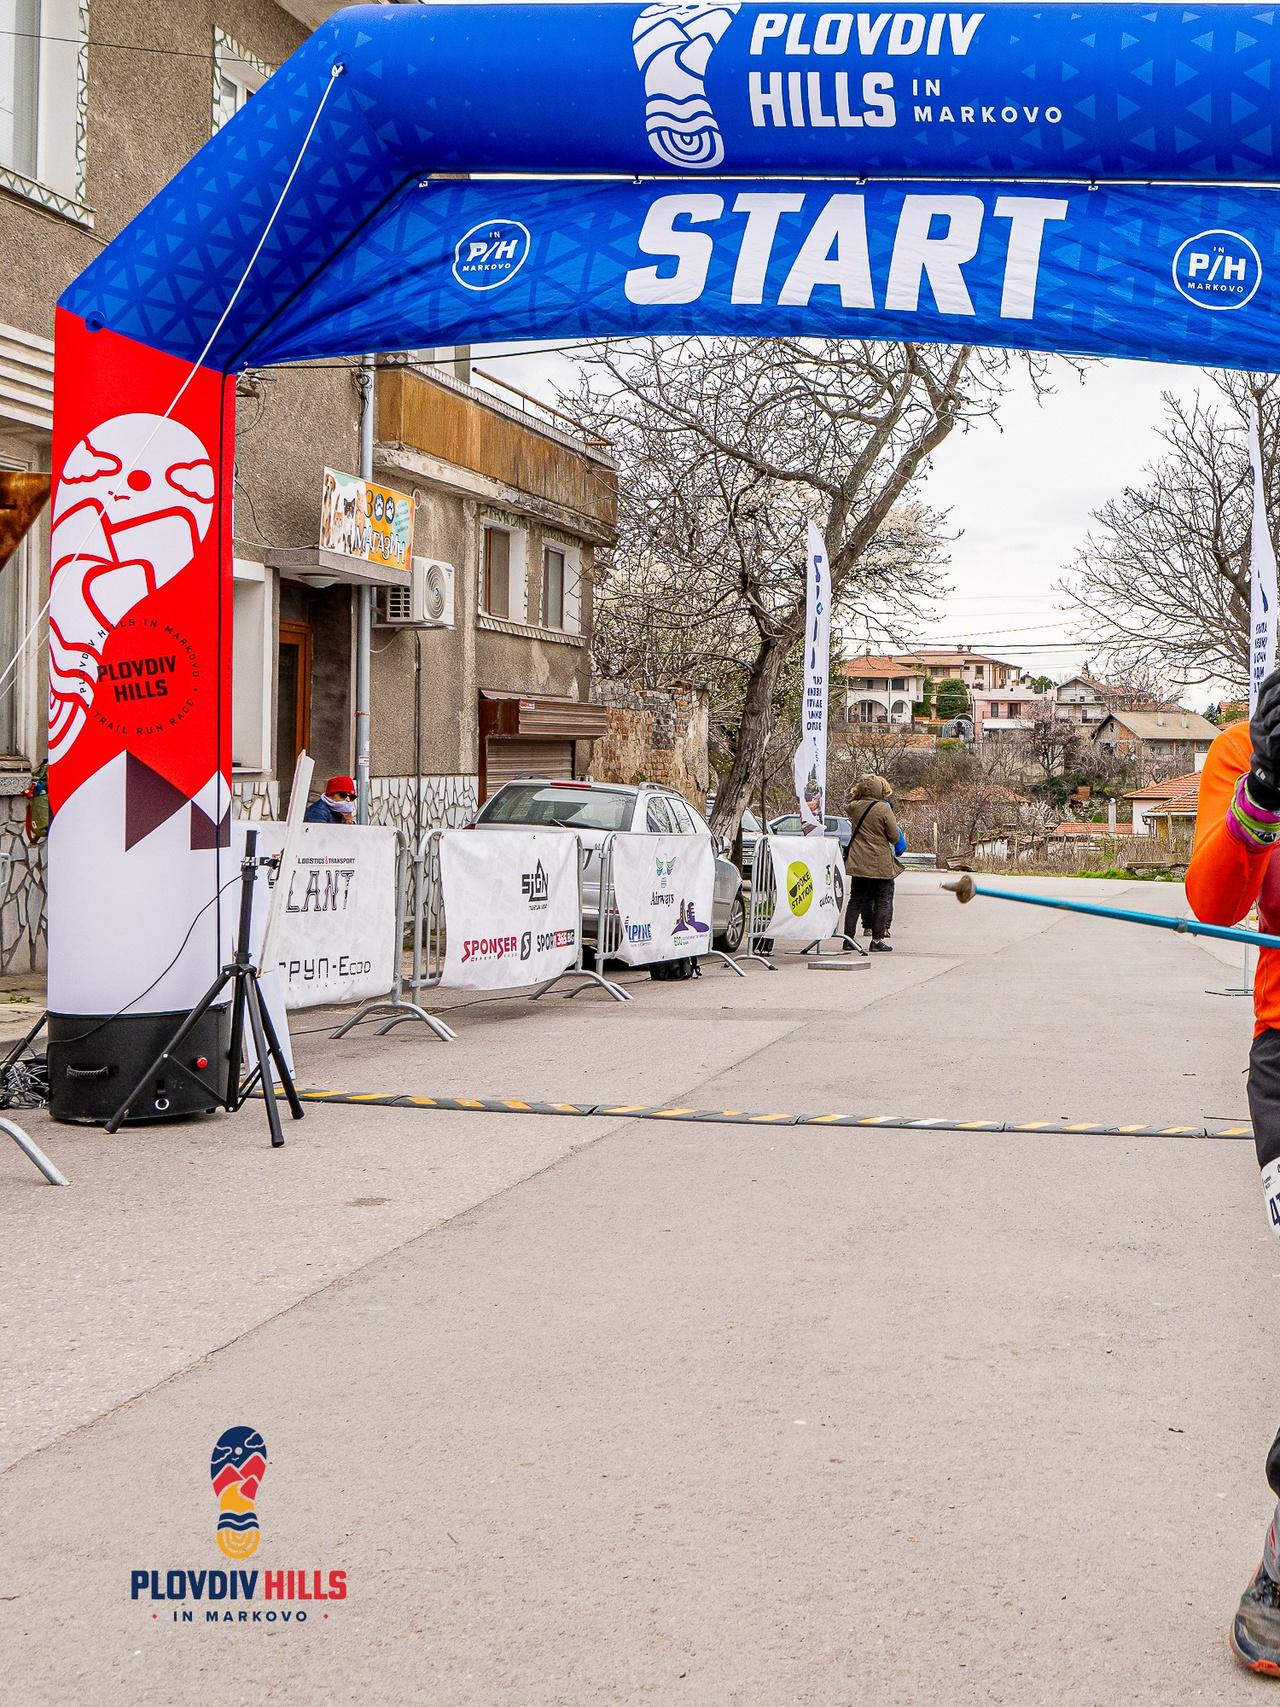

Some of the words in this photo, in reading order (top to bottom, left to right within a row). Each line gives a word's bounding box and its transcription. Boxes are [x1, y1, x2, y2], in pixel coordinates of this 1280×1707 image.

[749, 12, 986, 56] PLOVDIV
[748, 71, 897, 128] HILLS
[912, 79, 941, 97] IN
[914, 106, 1063, 124] MARKOVO
[489, 231, 501, 239] IN
[466, 239, 519, 263] P/H
[624, 192, 1070, 320] START
[1213, 246, 1225, 254] IN
[462, 262, 512, 272] MARKOVO
[1188, 252, 1247, 282] P/H
[1187, 282, 1244, 294] MARKOVO
[354, 525, 406, 565] МАГАЗИН
[78, 639, 97, 694] PLOVDIV
[97, 618, 136, 638] HILLS
[144, 618, 158, 628] IN
[163, 625, 200, 678] MARKOVO
[96, 655, 177, 683] PLOVDIV
[113, 679, 168, 703] HILLS
[93, 711, 128, 735] TRAIL
[136, 724, 164, 736] RUN
[169, 699, 195, 726] RACE
[650, 892, 674, 907] Airways
[791, 884, 813, 910] STATION
[461, 936, 518, 963] SPONSER
